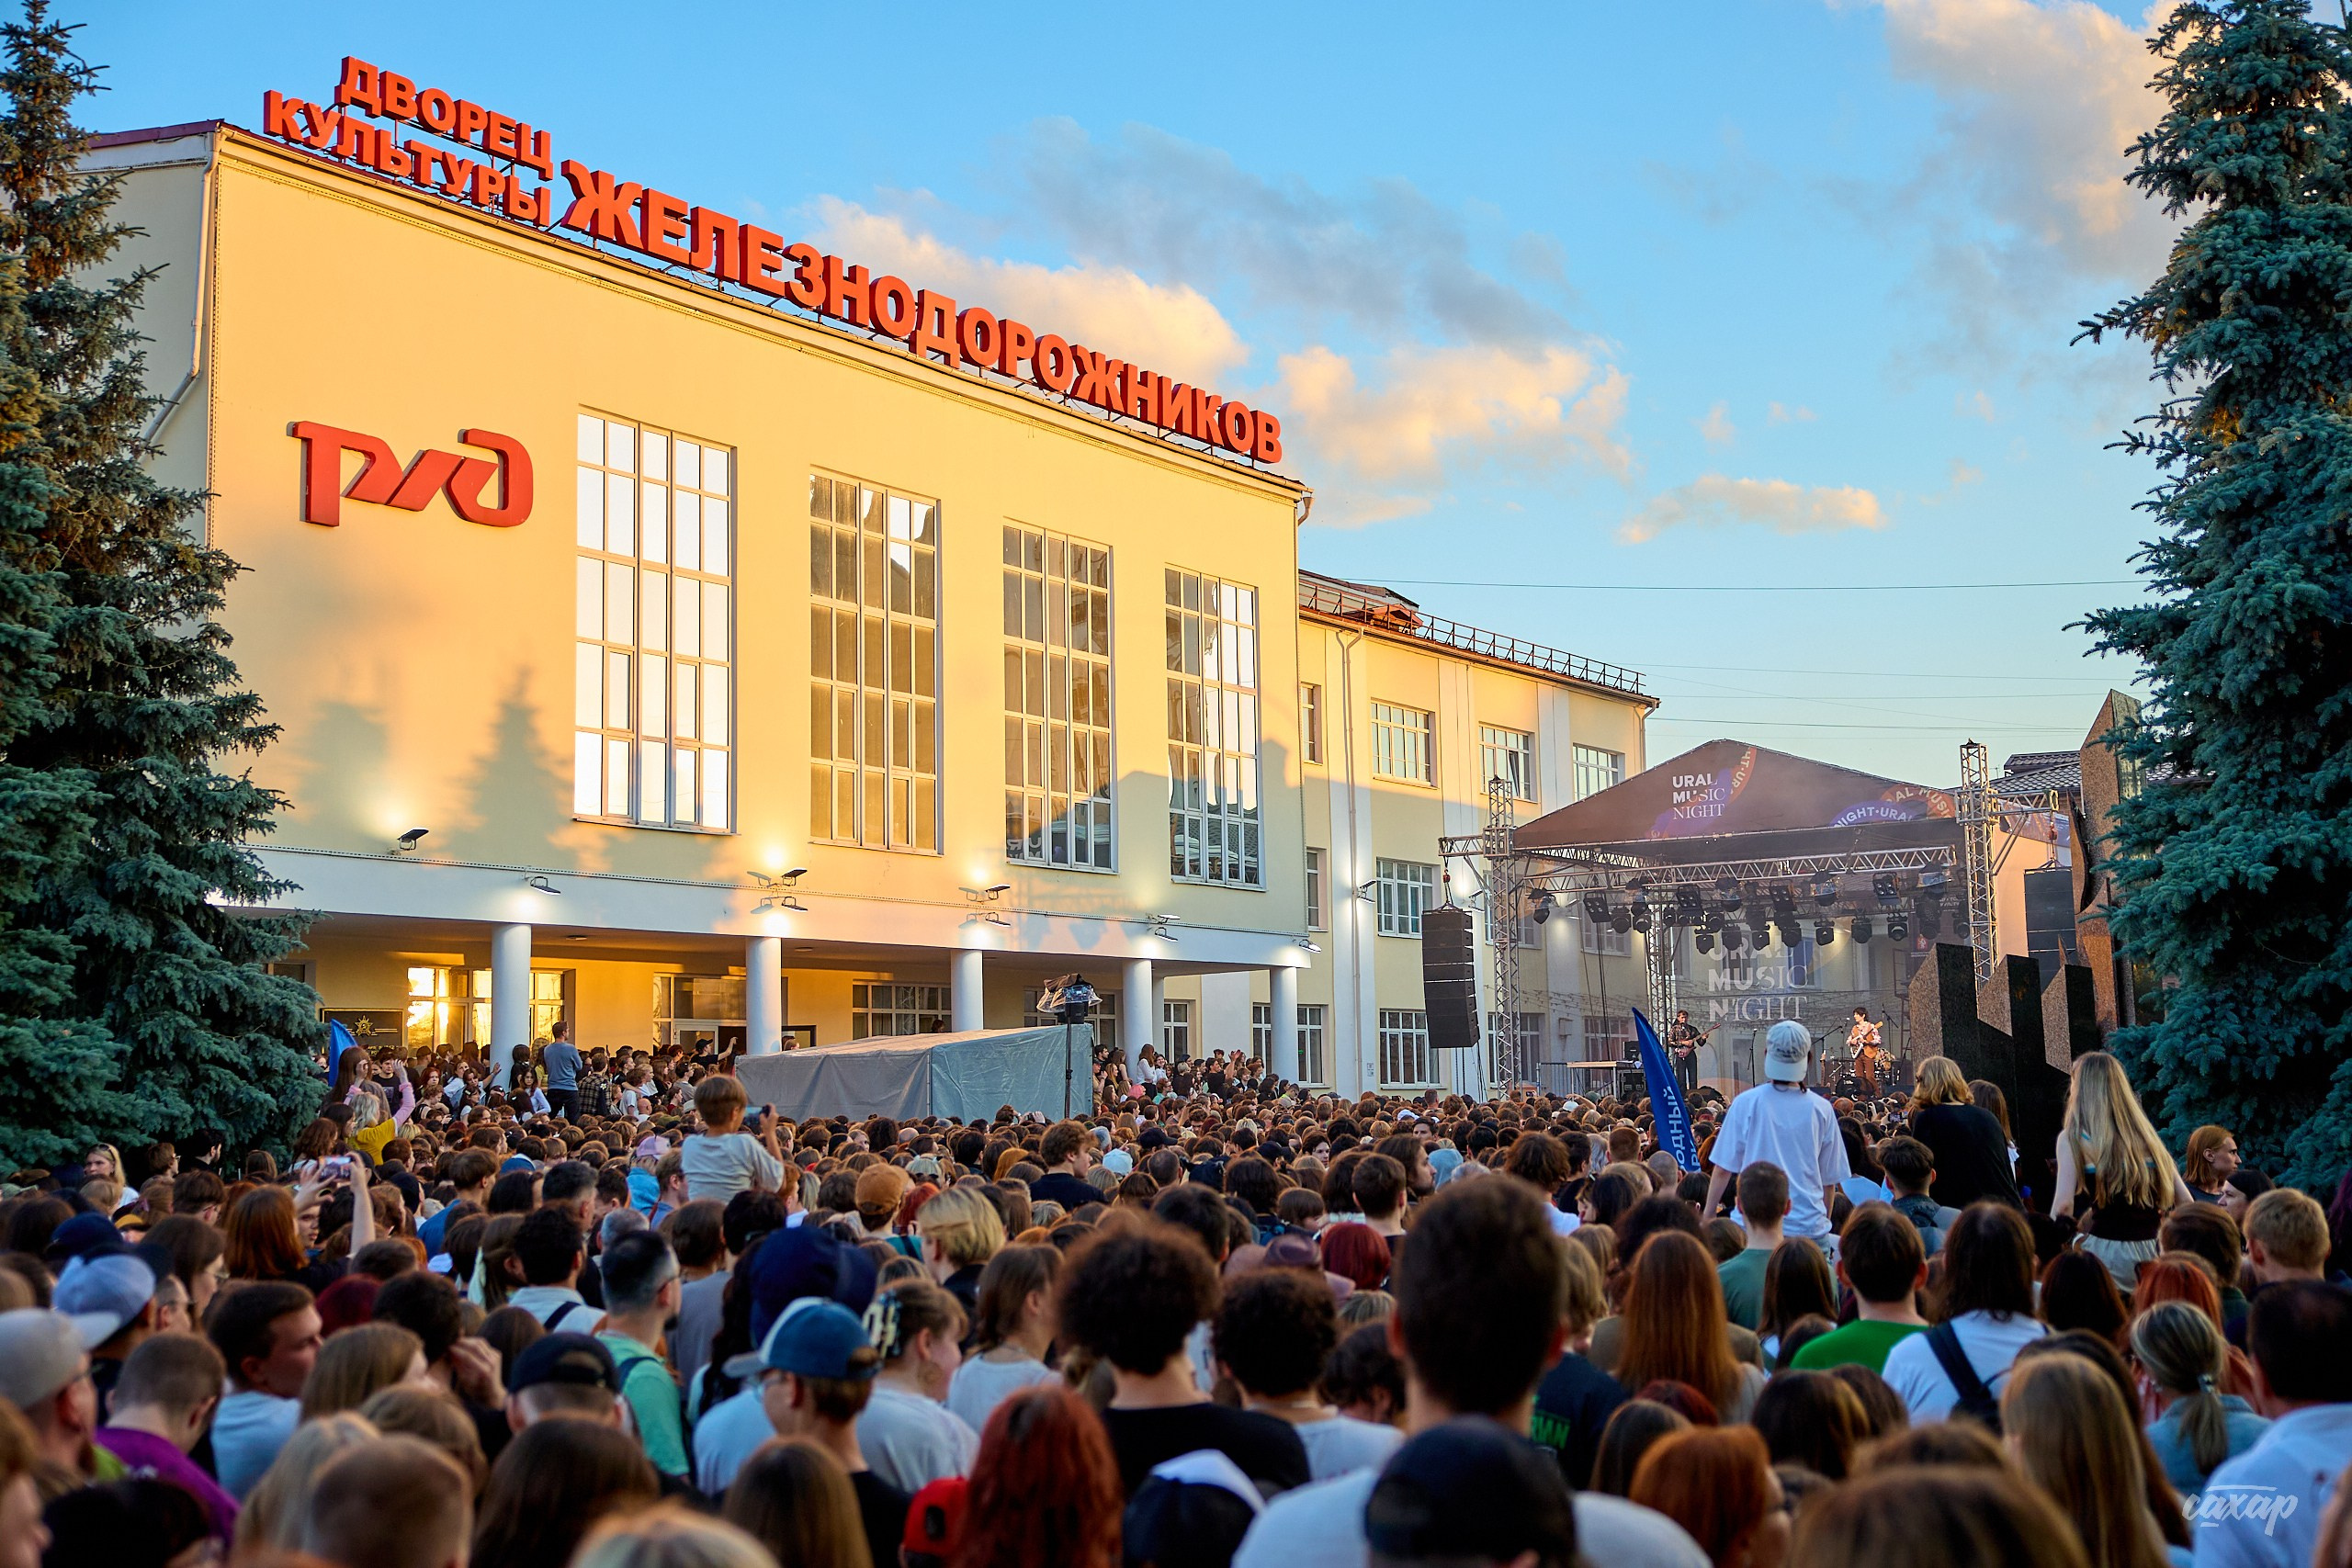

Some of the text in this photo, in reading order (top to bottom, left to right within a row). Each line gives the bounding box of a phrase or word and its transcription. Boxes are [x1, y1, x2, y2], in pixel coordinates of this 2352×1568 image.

[334, 56, 553, 181] ДВОРЕЦ
[264, 90, 550, 227] КУЛЬТУРЫ
[560, 159, 1283, 464] ЖЕЛЕЗНОДОРОЖНИКОВ
[1672, 773, 1717, 788] URAL
[1672, 788, 1725, 804] MUSIC
[1672, 804, 1725, 820] NIGHT
[1708, 964, 1808, 992] MUSIC
[1709, 996, 1808, 1022] NIGHT
[1663, 1086, 1687, 1171] ОДНЫЙ
